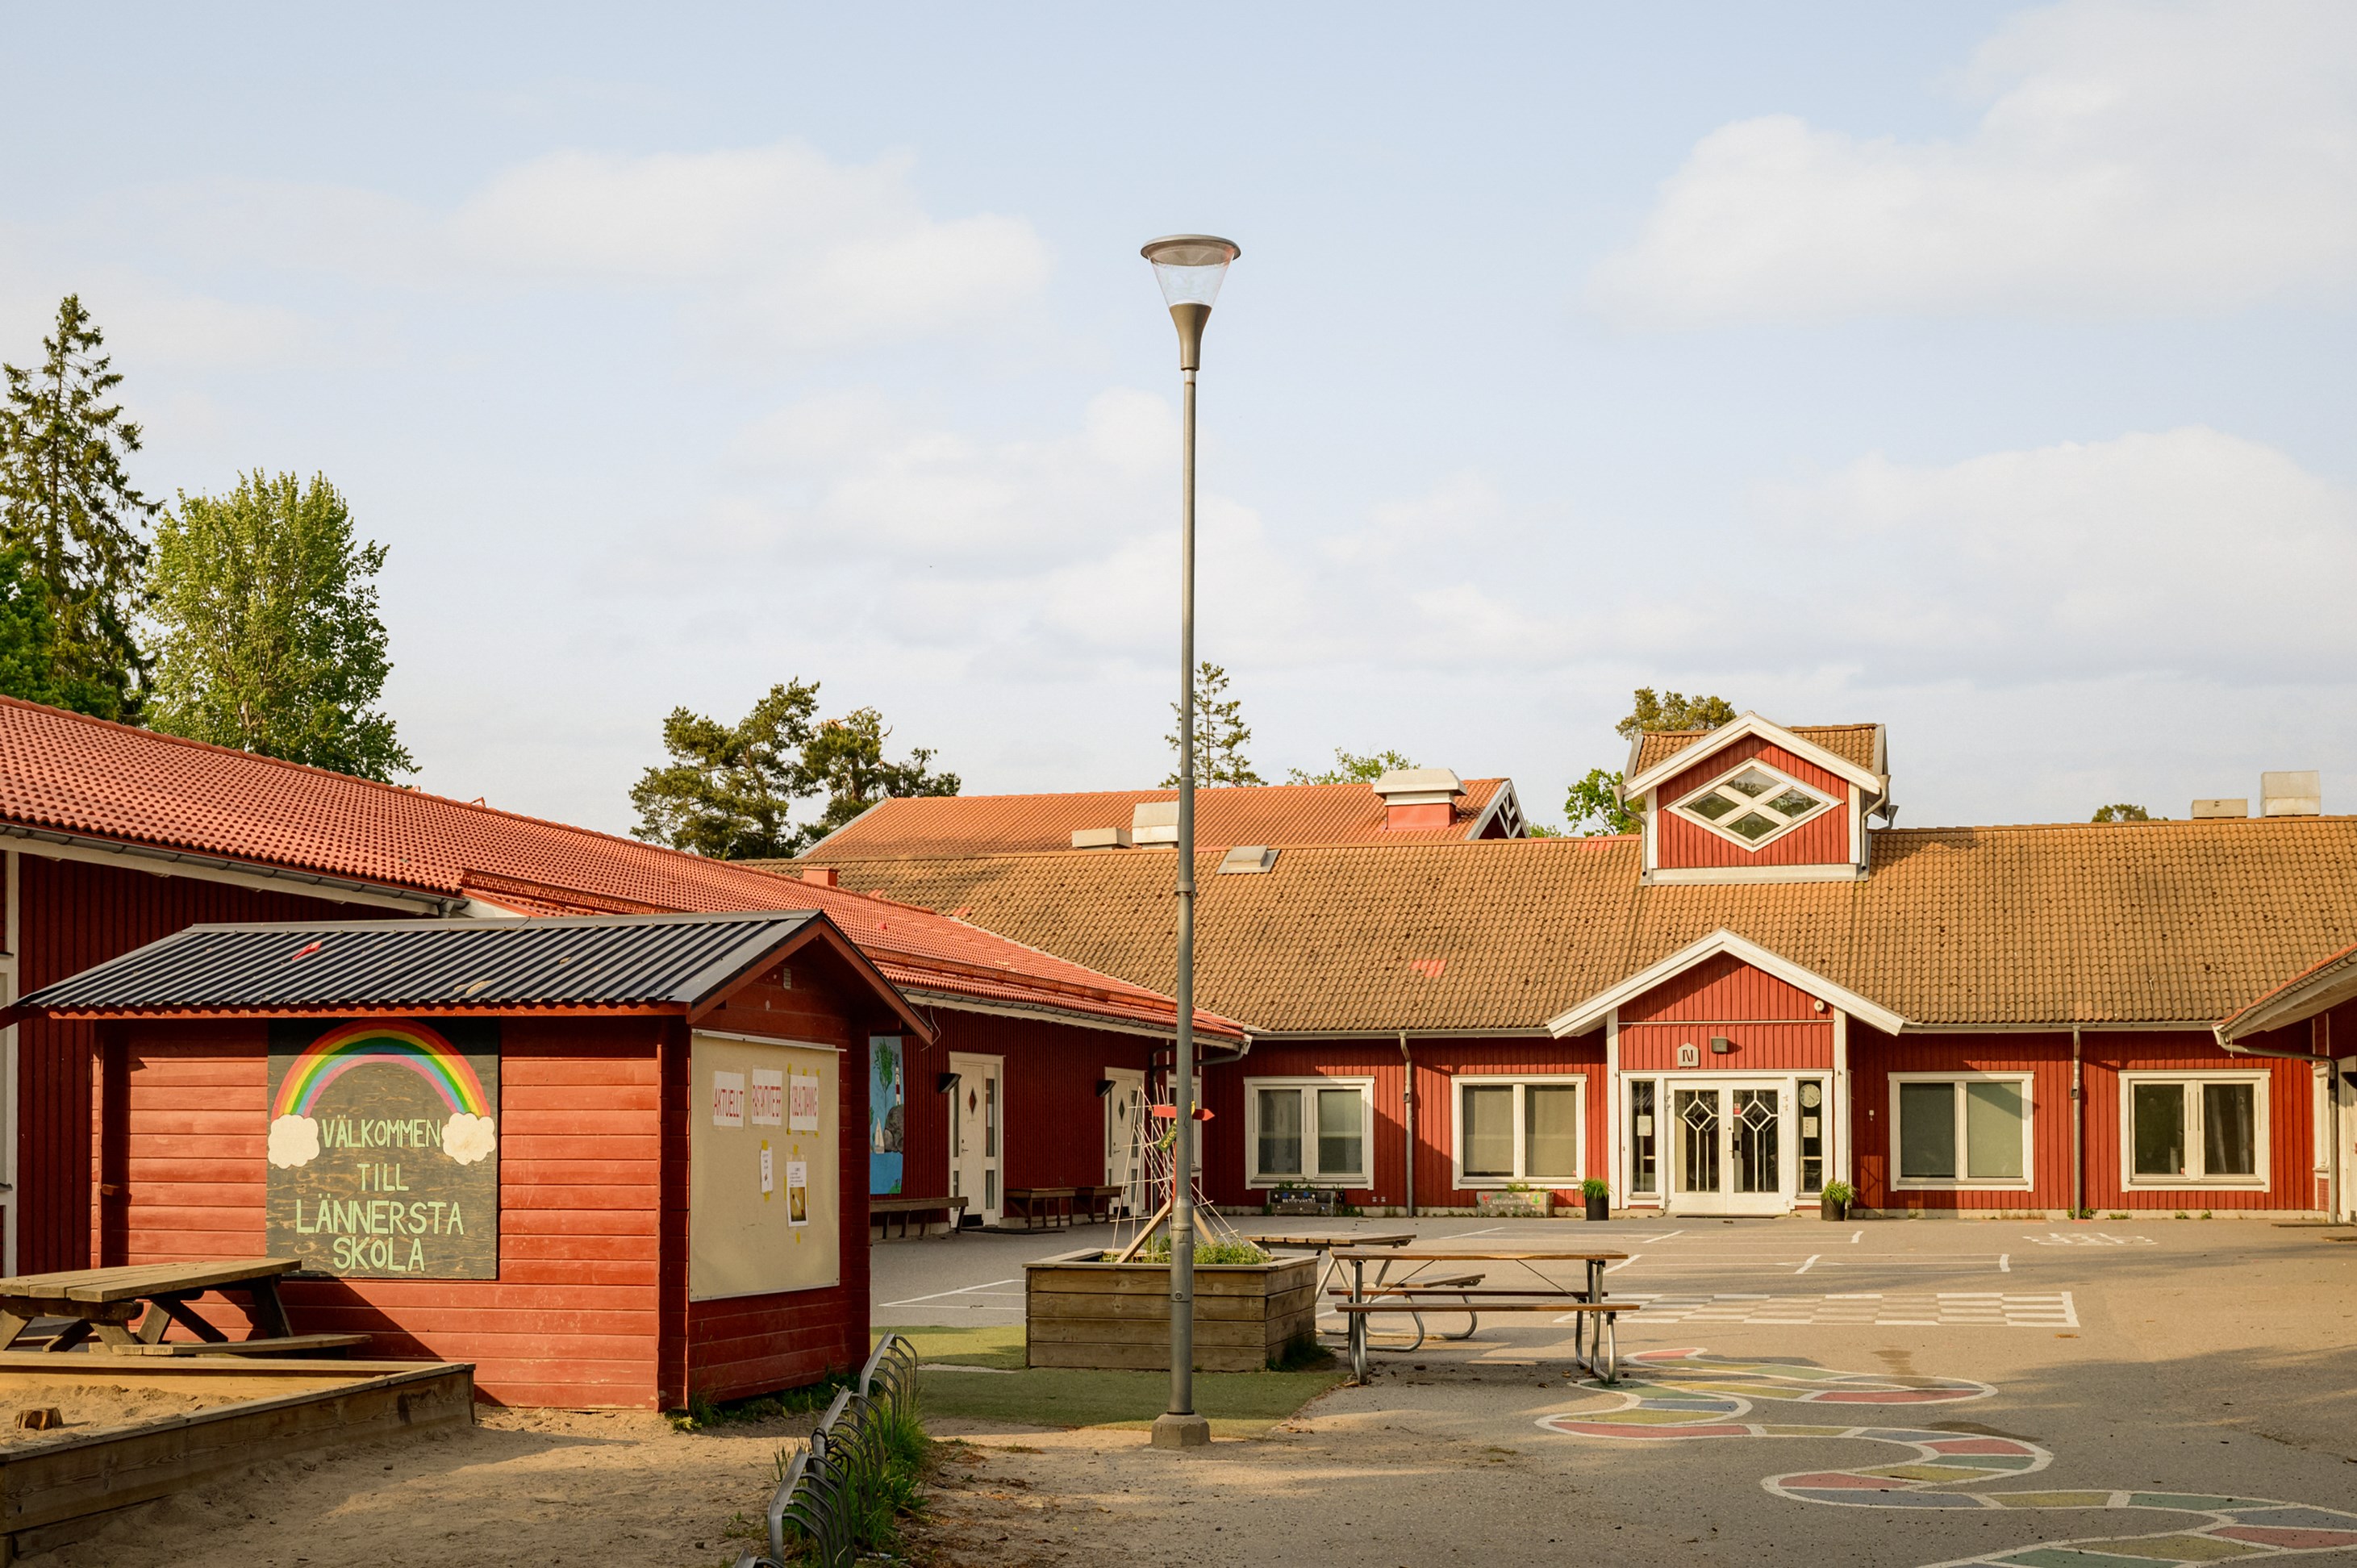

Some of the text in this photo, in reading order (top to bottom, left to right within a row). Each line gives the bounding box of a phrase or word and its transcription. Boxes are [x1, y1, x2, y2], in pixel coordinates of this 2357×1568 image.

[713, 1088, 744, 1118] AKTUELLT
[322, 1114, 441, 1148] VÄLKOMMEN
[357, 1163, 410, 1191] TILL
[295, 1193, 465, 1236] LÄNNERSTA
[332, 1236, 425, 1272] SKOLA
